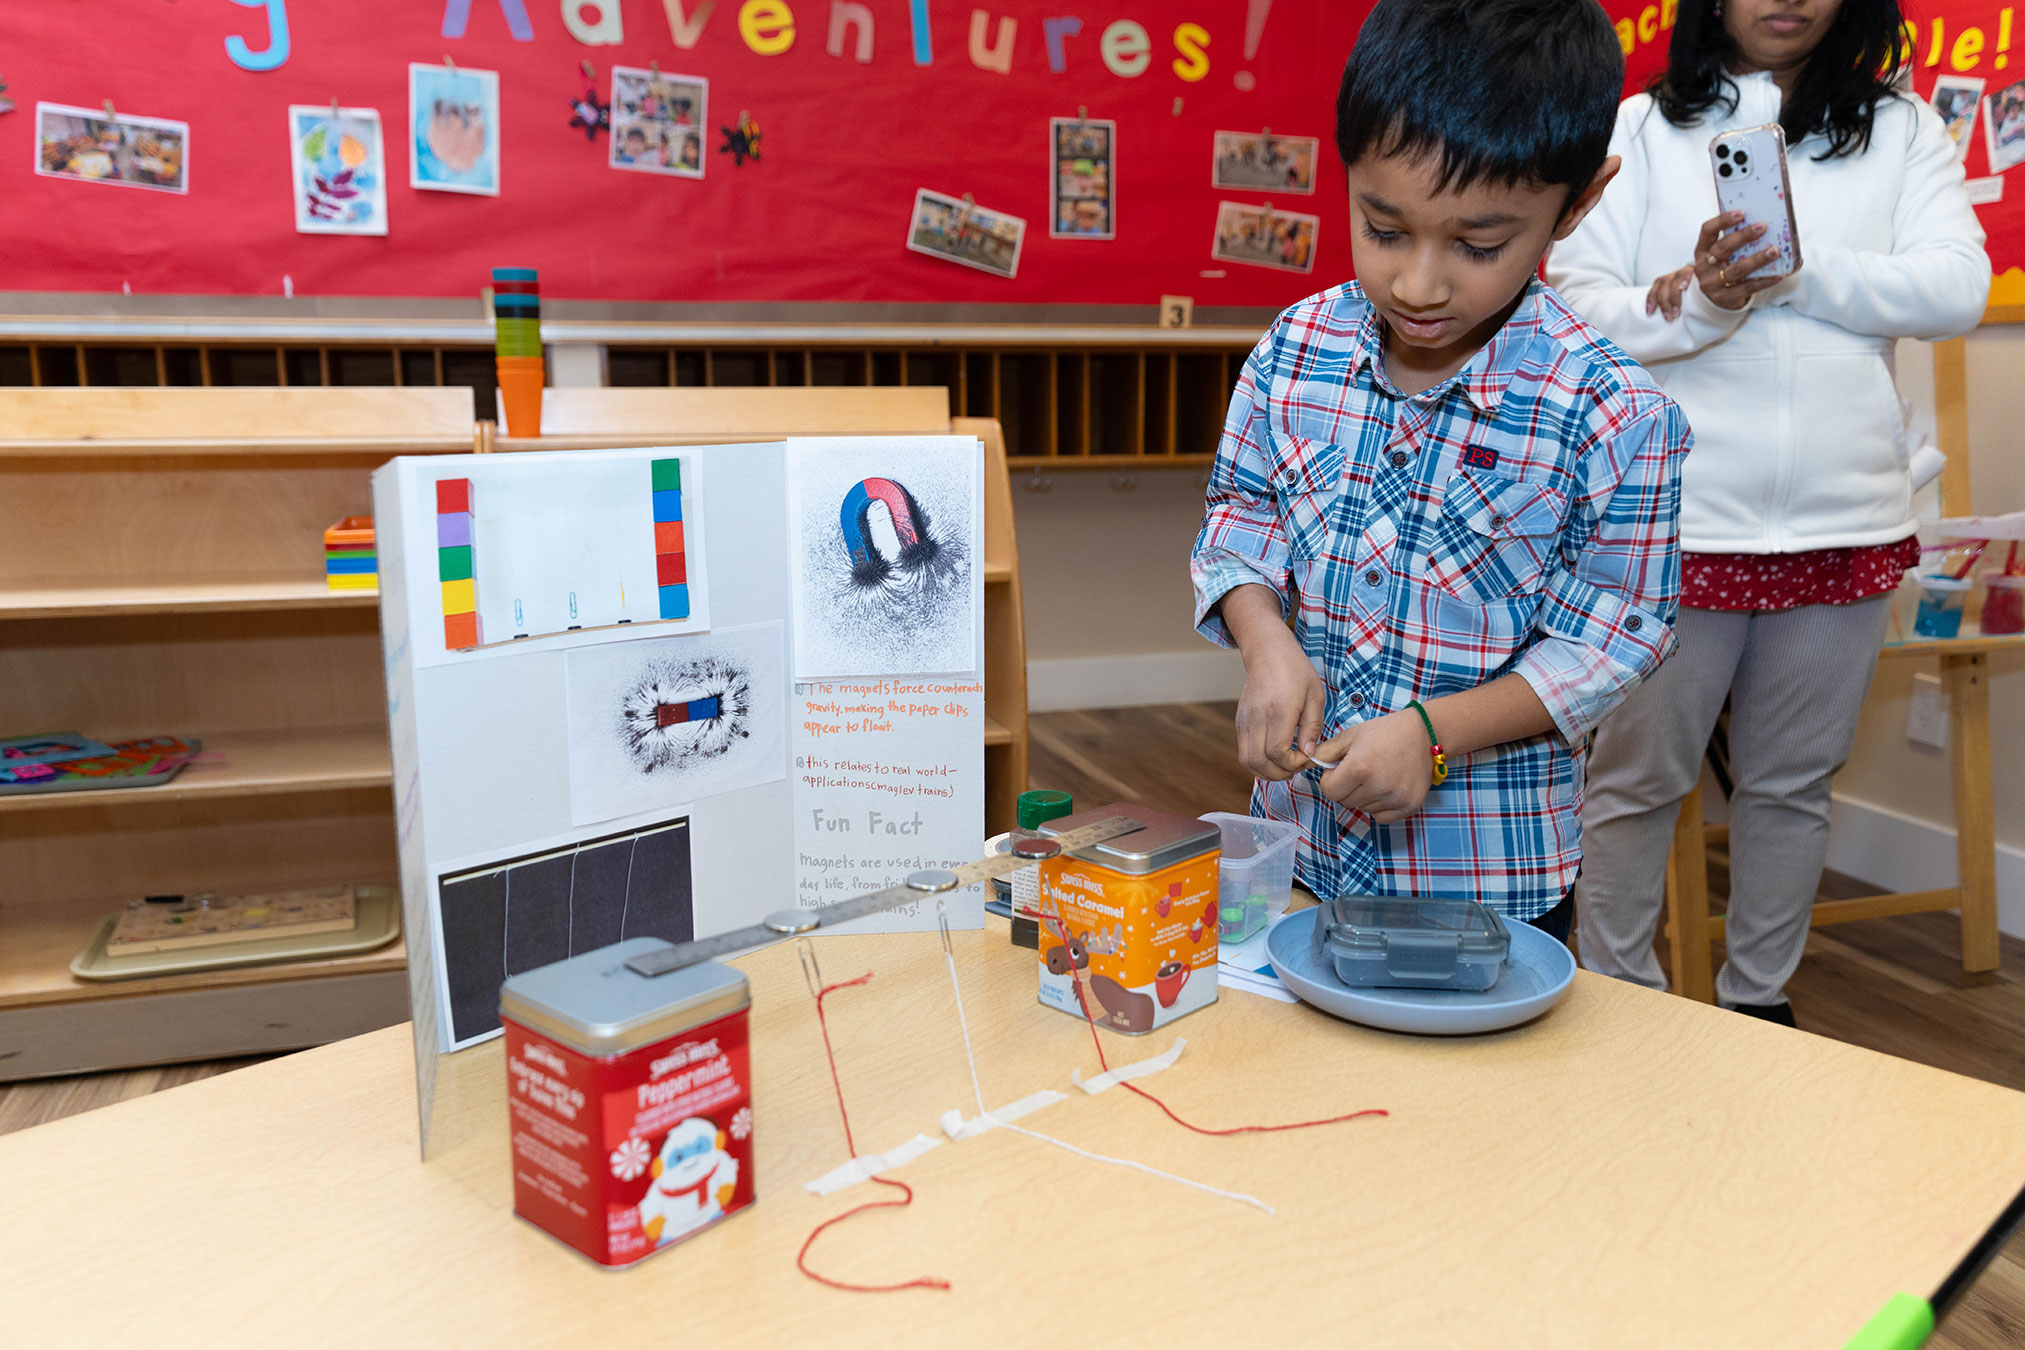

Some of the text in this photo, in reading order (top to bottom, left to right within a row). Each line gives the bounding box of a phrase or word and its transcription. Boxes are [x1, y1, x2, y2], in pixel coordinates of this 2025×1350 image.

[1170, 303, 1184, 328] 3
[1467, 447, 1496, 467] PS
[840, 679, 891, 698] magnets
[892, 679, 925, 695] force
[887, 699, 906, 713] the
[909, 703, 940, 717] paper
[944, 701, 969, 717] clips
[803, 718, 895, 737] appear to float.
[806, 755, 829, 769] this
[834, 760, 872, 773] relates
[874, 761, 889, 775] to
[892, 765, 911, 775] real
[917, 783, 954, 798] trains)
[812, 808, 923, 835] Fun Fact
[860, 859, 882, 868] are
[887, 855, 922, 869] used
[924, 858, 937, 868] in
[800, 877, 819, 891] day
[825, 877, 849, 891] life,
[851, 876, 881, 889] from
[1077, 894, 1125, 919] Caramel
[637, 1053, 732, 1108] Peppermint
